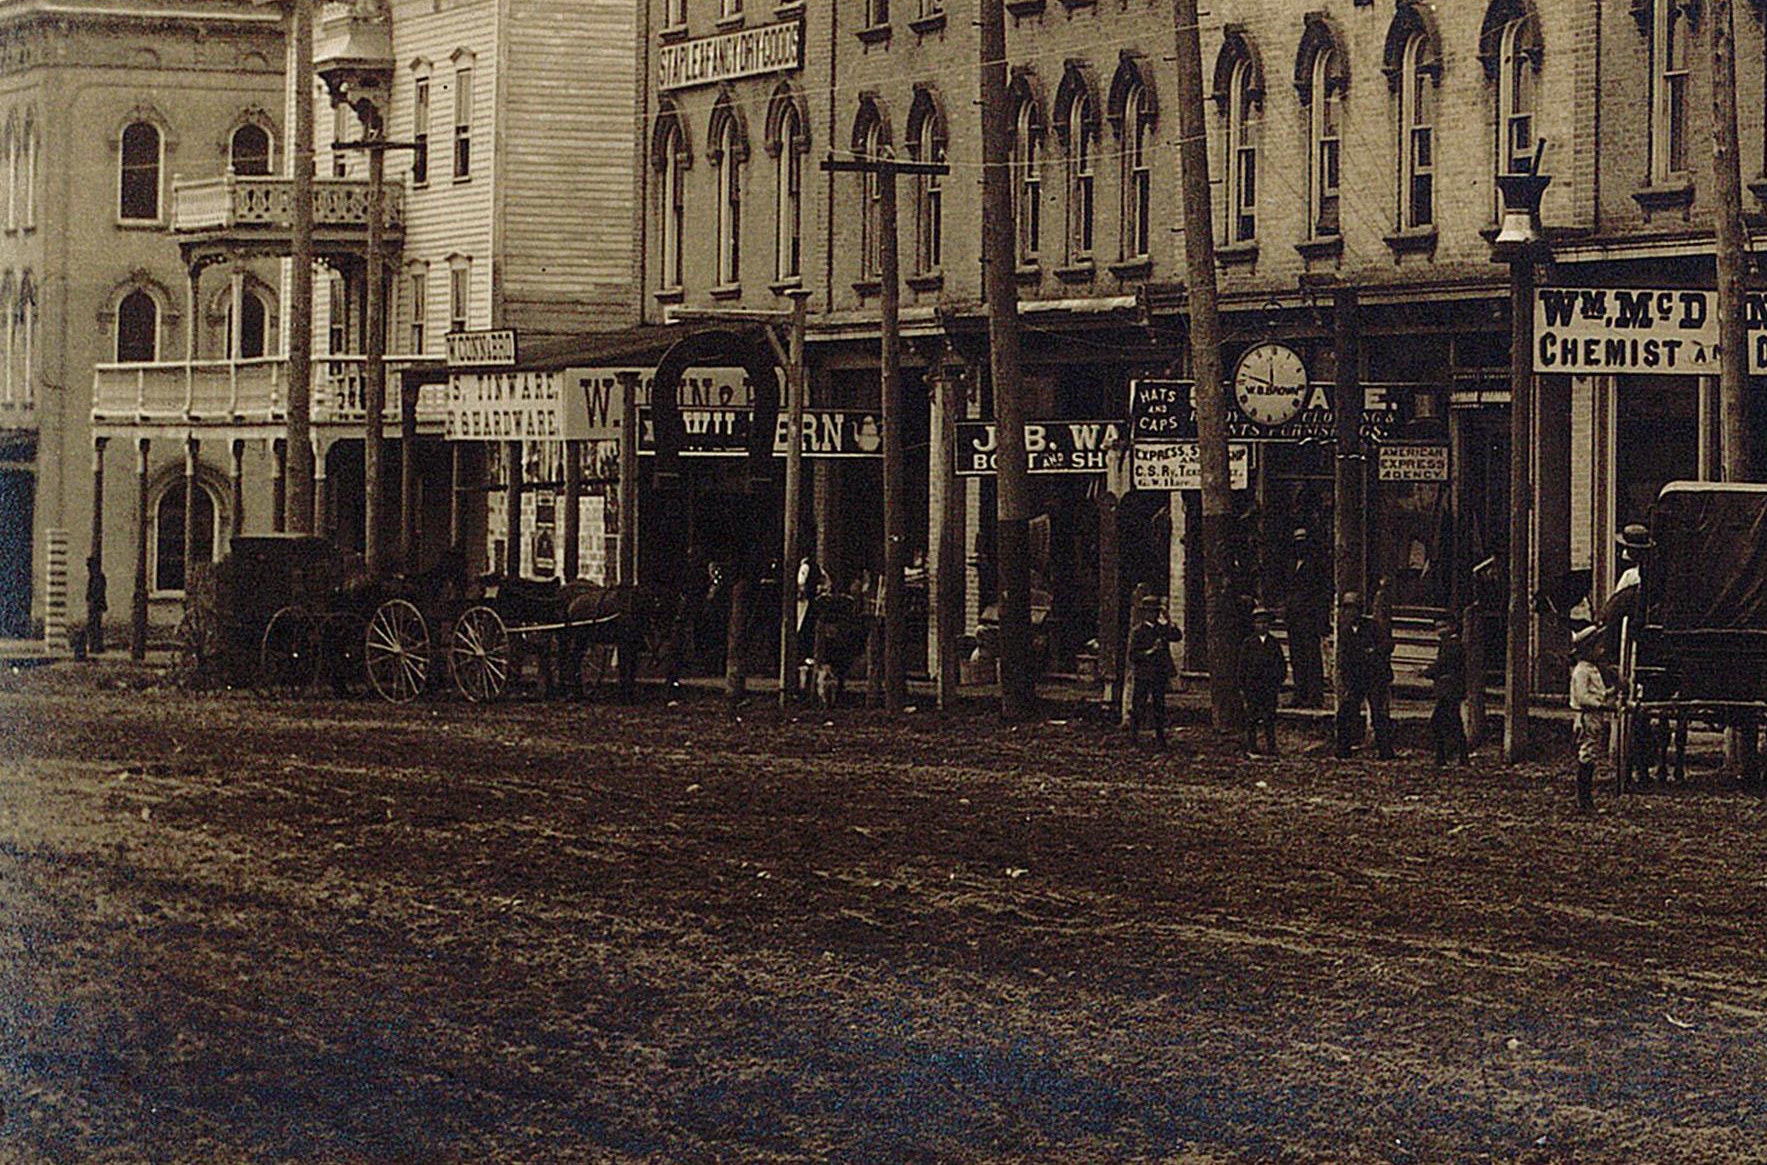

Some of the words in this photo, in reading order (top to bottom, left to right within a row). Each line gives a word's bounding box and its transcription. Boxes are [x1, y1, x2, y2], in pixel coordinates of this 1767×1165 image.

[1539, 331, 1683, 368] CHEMIST
[1140, 388, 1177, 404] HATS
[1147, 404, 1168, 414] AND
[1139, 415, 1178, 432] CAPS
[1382, 447, 1443, 457] AMERICAN
[973, 452, 1039, 470] BT
[1042, 451, 1065, 468] AND
[1071, 452, 1108, 469] SH
[1380, 458, 1445, 469] EXPRESS
